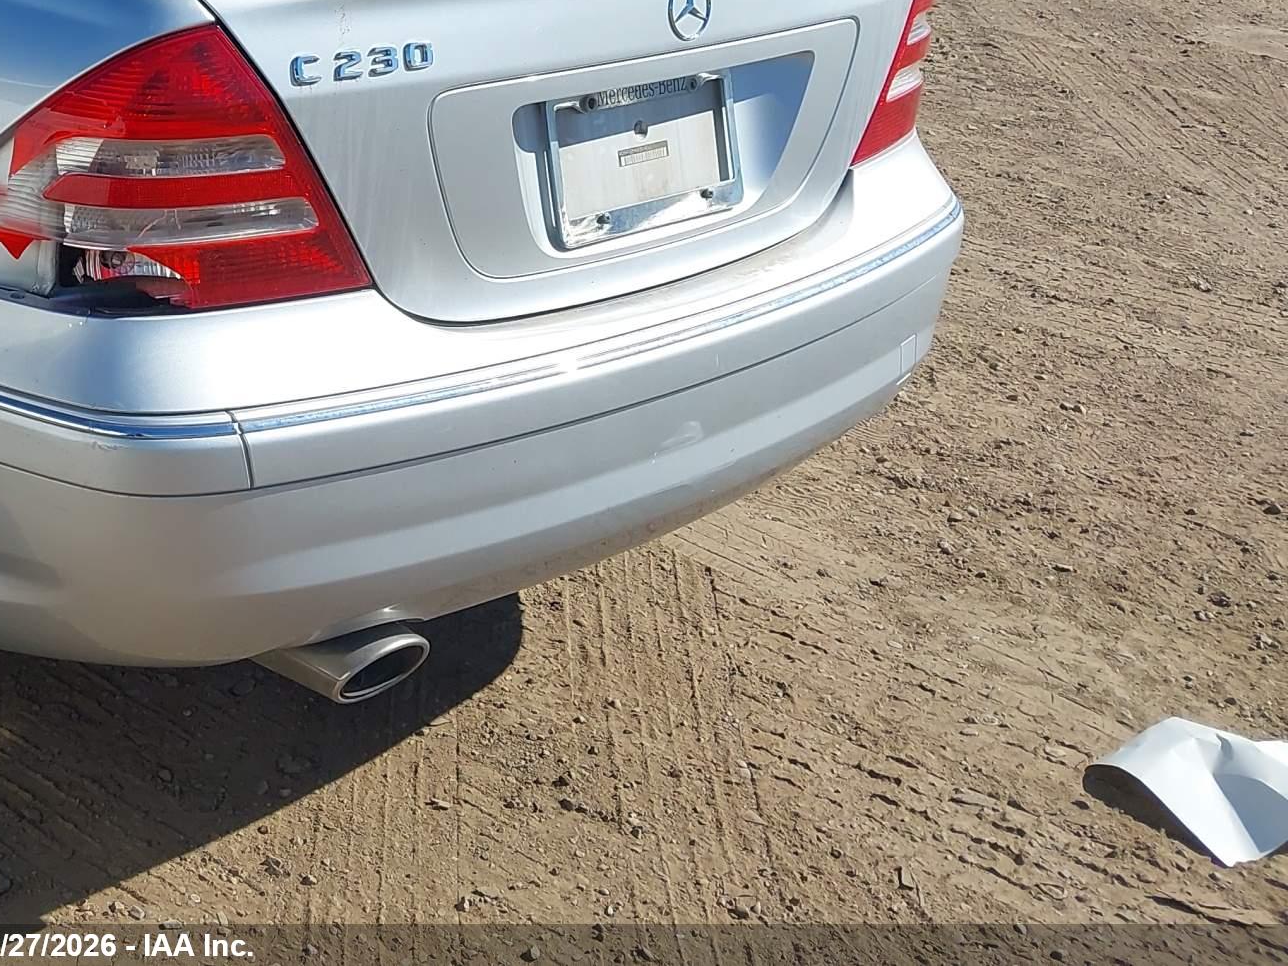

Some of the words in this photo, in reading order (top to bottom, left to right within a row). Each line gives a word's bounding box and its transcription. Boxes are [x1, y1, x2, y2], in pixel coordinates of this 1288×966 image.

[289, 55, 322, 87] C
[333, 42, 434, 82] 230
[597, 77, 687, 107] Mercedes-Benz
